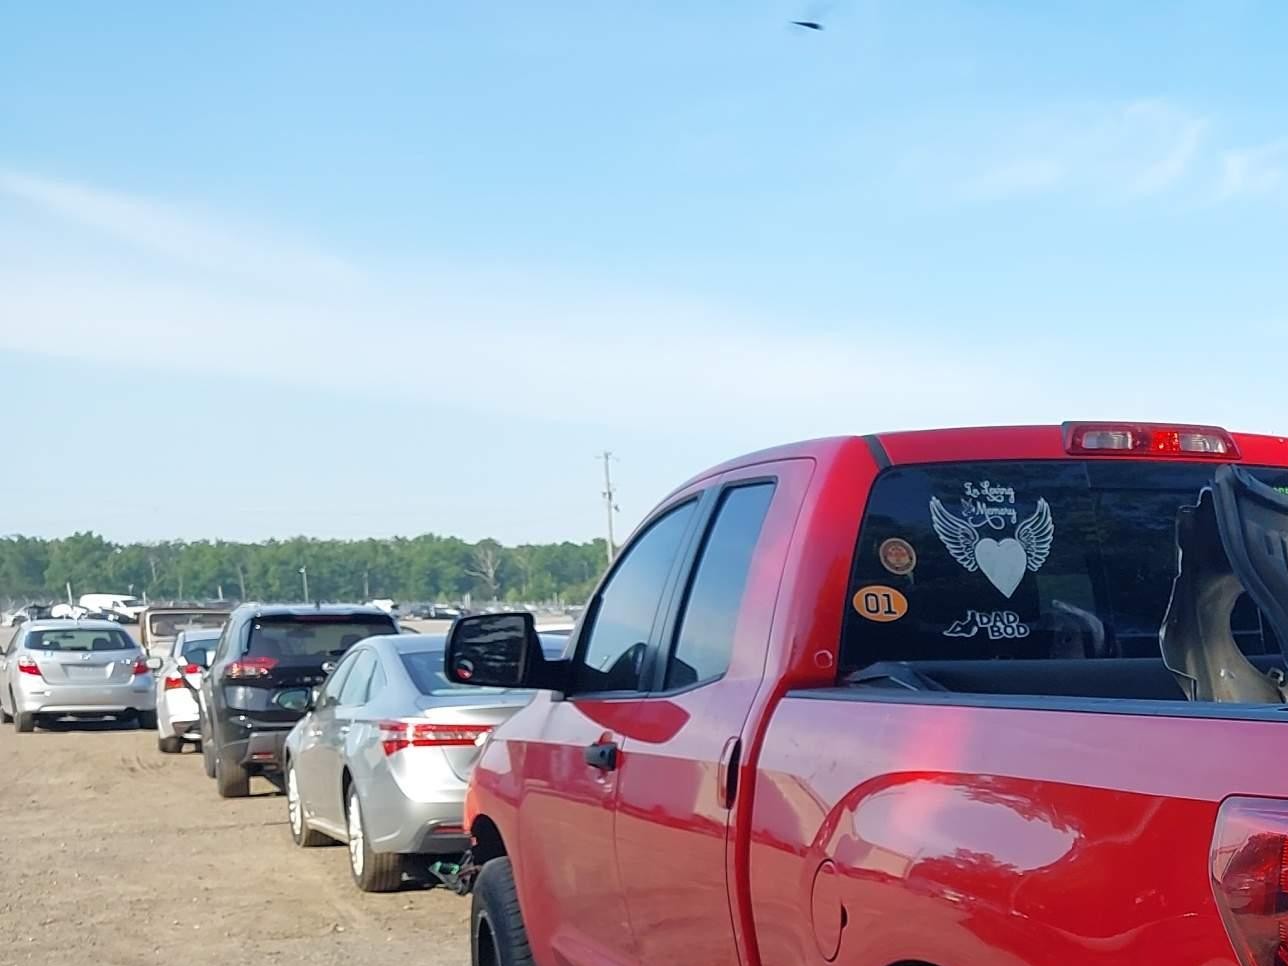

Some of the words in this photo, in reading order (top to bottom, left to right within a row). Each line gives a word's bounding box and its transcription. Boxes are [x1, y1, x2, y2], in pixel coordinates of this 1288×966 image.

[864, 592, 897, 615] 01
[975, 610, 1020, 628] DAD
[987, 622, 1030, 640] BOD
